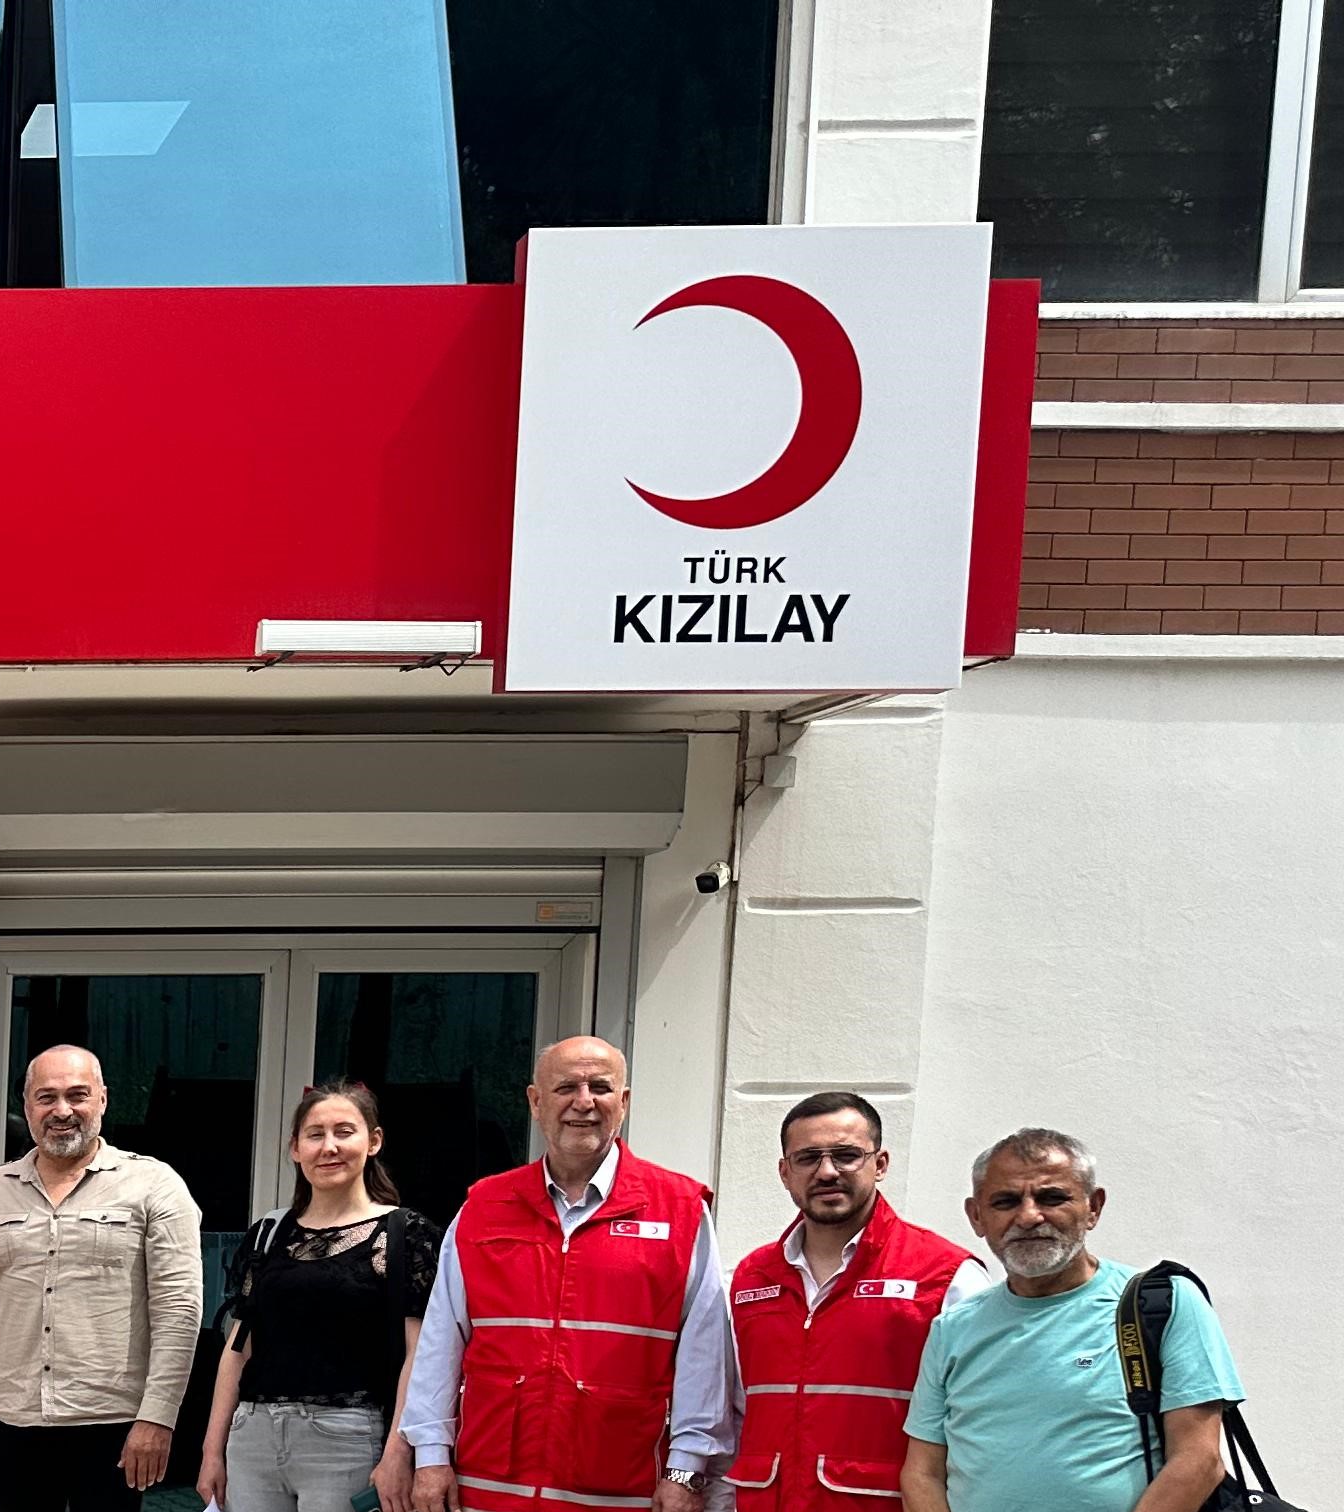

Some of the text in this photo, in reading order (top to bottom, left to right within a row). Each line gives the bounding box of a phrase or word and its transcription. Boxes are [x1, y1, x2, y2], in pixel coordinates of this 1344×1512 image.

[683, 549, 787, 584] TÜRK
[612, 593, 851, 643] KIZILAY
[1121, 1322, 1144, 1387] Nikon D500
